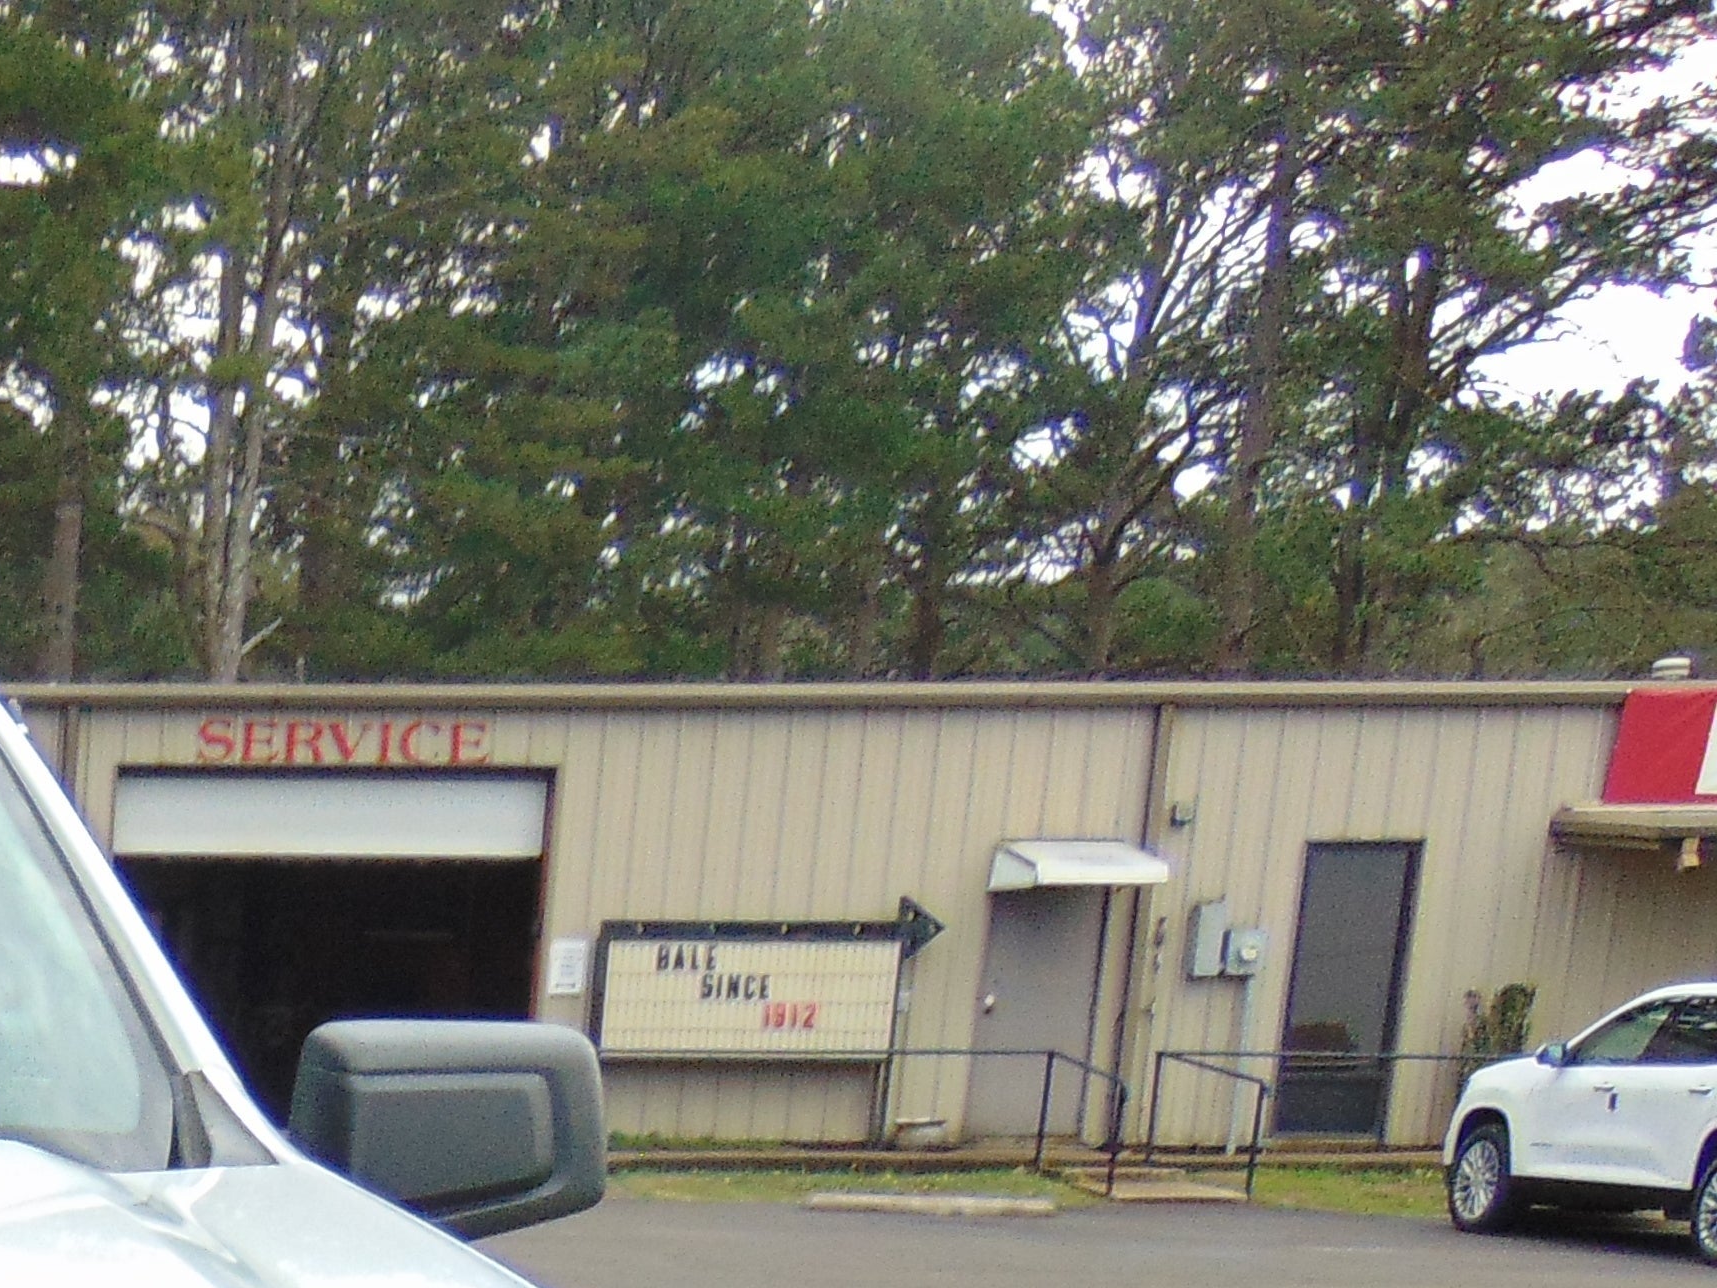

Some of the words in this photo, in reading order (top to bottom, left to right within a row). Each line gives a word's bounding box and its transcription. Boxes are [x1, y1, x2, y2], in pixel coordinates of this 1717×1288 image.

[197, 717, 492, 765] SERVICE
[700, 973, 771, 1001] SINCE
[763, 1002, 817, 1029] 1912
